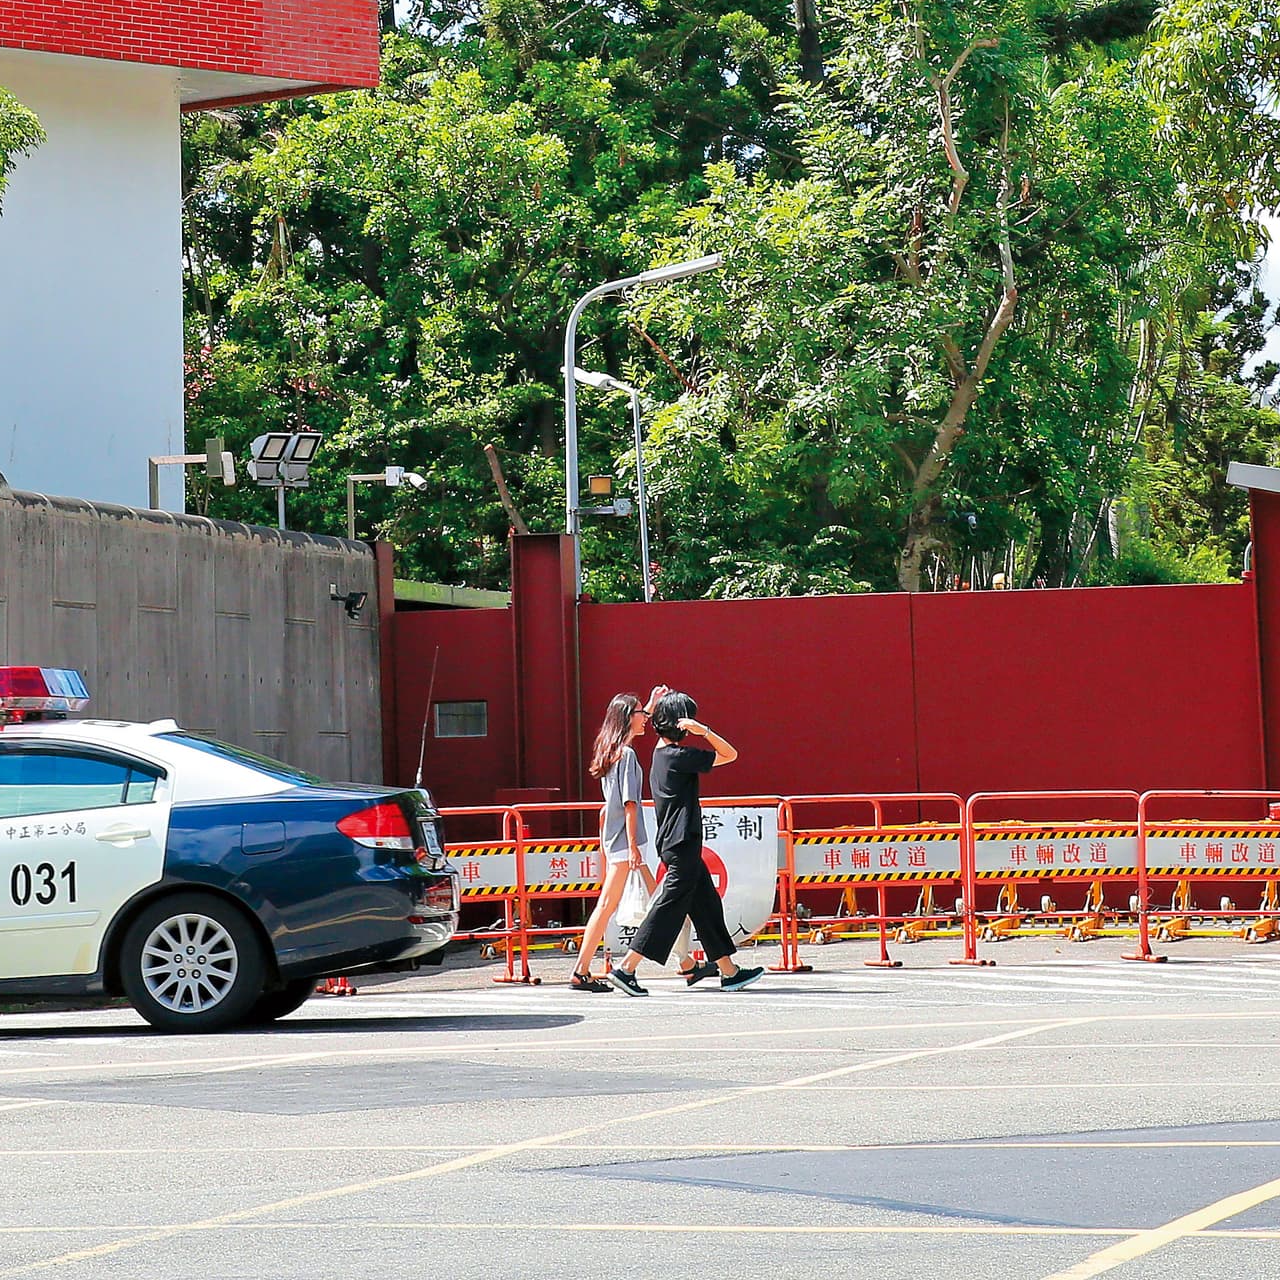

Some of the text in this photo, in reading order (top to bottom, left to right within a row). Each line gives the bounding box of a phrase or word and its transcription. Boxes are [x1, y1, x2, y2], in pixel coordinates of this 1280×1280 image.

[6, 822, 86, 840] 中正第二分局
[824, 846, 927, 870] 車輛改道
[1009, 842, 1108, 866] 車輛改道
[1180, 842, 1276, 864] 車輛改道
[461, 861, 481, 884] 車
[549, 856, 598, 879] 禁止
[10, 861, 77, 907] 031
